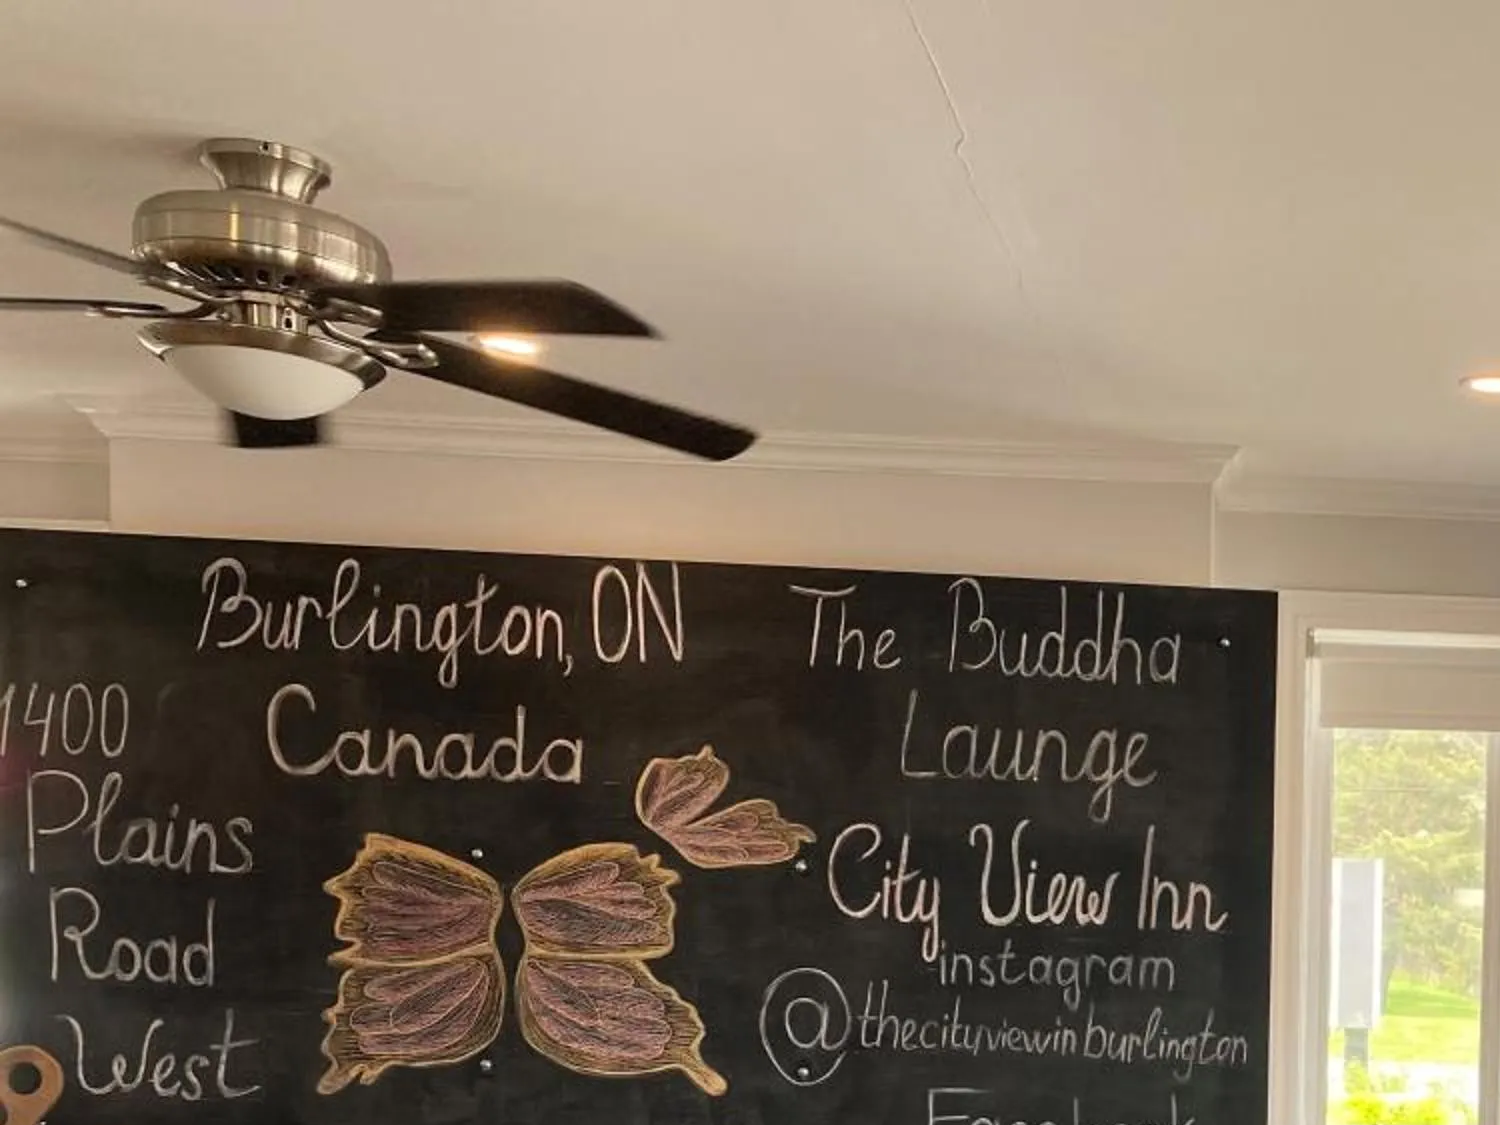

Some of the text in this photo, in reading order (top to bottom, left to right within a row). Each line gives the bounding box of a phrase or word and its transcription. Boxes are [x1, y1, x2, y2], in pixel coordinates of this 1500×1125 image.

[197, 557, 684, 688] Burlington, ON
[788, 577, 1181, 685] The Buddha
[0, 682, 129, 757] 1400
[266, 683, 583, 784] Canada
[902, 688, 1158, 822] Launge
[27, 769, 253, 874] Plains
[50, 887, 216, 987] Road
[827, 819, 1229, 963] City View Inn
[938, 938, 1175, 1011] instagram
[54, 1008, 261, 1101] West
